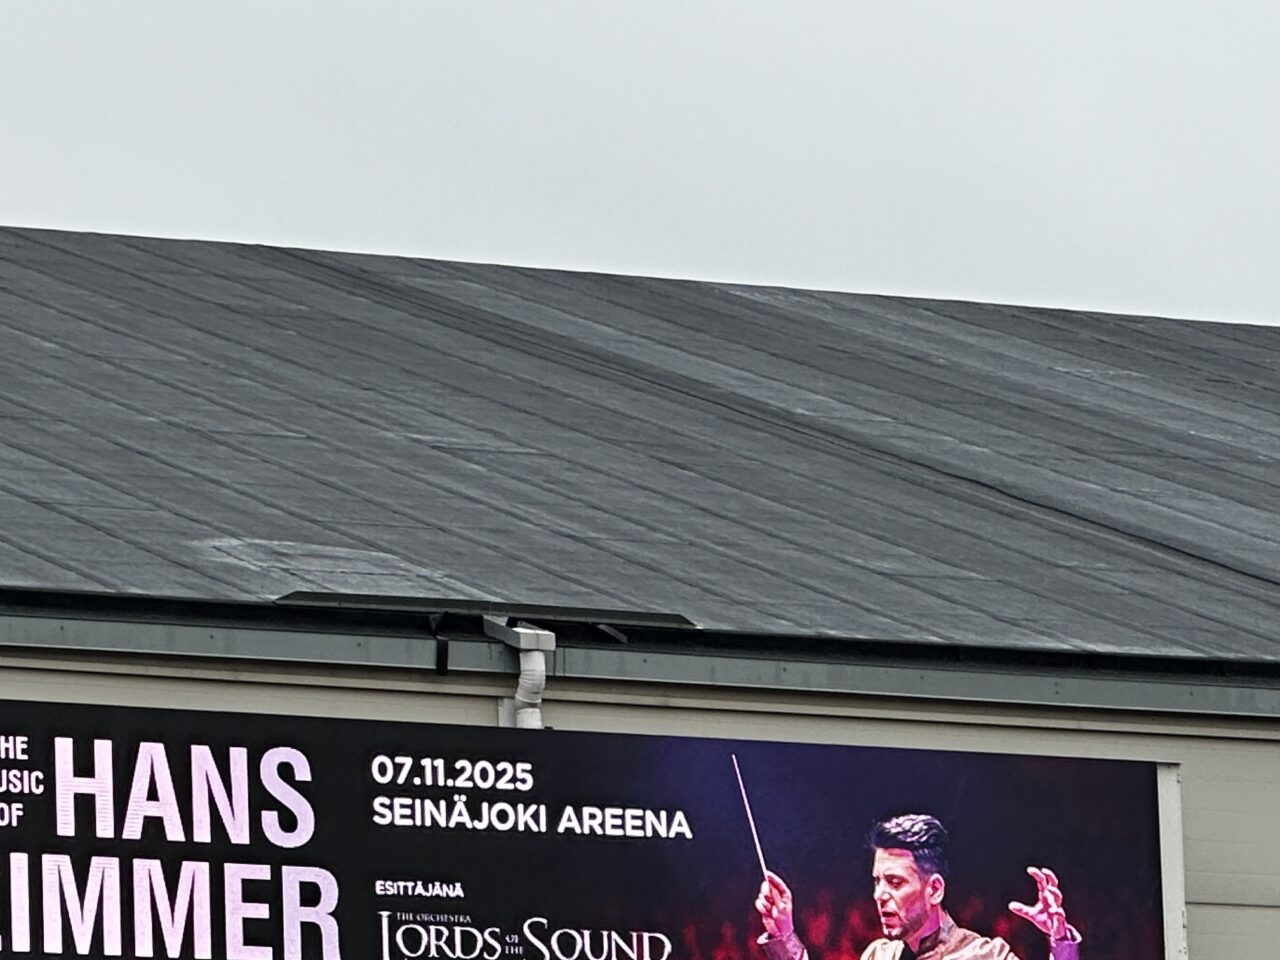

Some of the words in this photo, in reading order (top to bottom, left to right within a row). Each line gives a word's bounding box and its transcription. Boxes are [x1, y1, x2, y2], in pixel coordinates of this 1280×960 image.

[54, 736, 316, 849] HANS
[370, 754, 535, 792] 07.11.2025
[372, 794, 548, 832] SEINÄJOKI
[556, 804, 695, 839] AREENA
[374, 880, 465, 899] ESITTÄJÄNÄ
